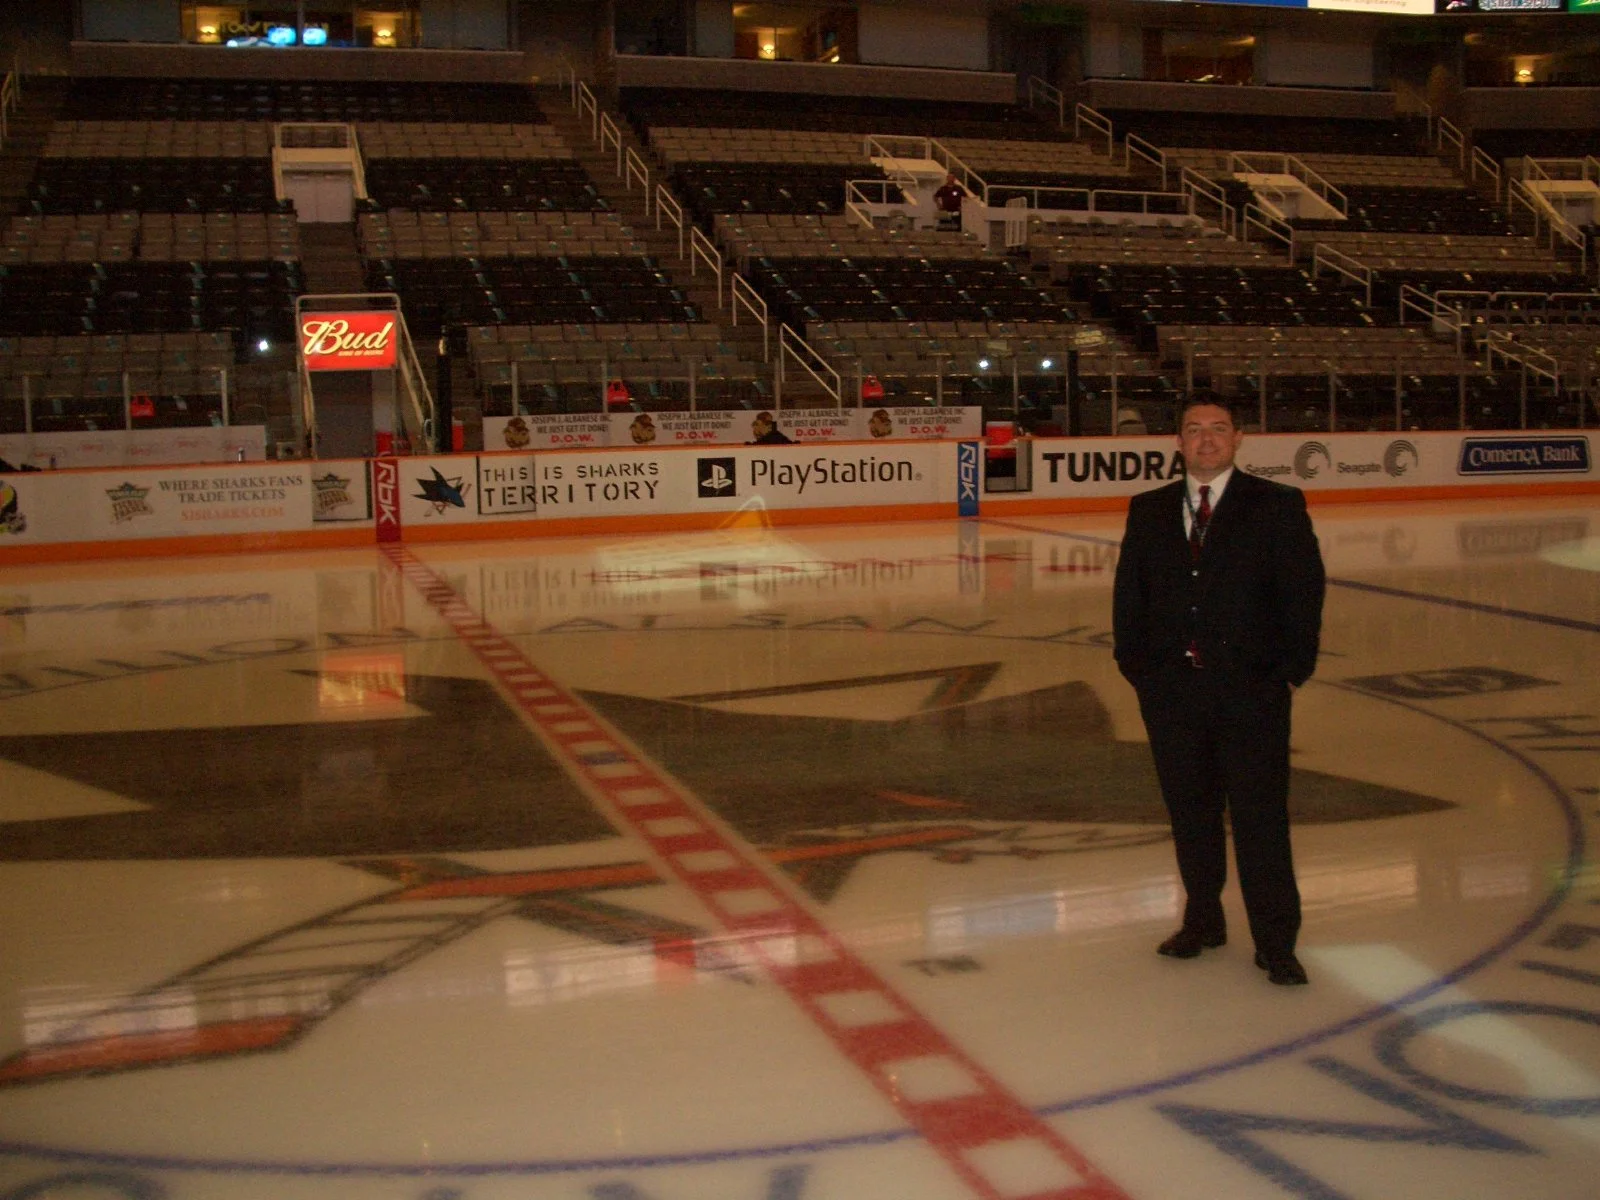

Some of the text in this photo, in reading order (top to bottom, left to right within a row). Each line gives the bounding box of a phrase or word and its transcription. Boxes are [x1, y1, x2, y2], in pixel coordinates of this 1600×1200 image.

[302, 319, 394, 355] Bud
[1543, 445, 1581, 462] Bank
[484, 462, 659, 482] THIS IS SHARKS
[751, 457, 913, 494] PlayStation
[1043, 451, 1187, 483] TUNDRA
[1245, 463, 1292, 477] Seagate
[1337, 461, 1382, 475] Seagate
[158, 475, 303, 491] WHERE SHARKS FANS
[178, 489, 286, 503] TRADE TICKETS
[484, 480, 659, 507] TERRITORY
